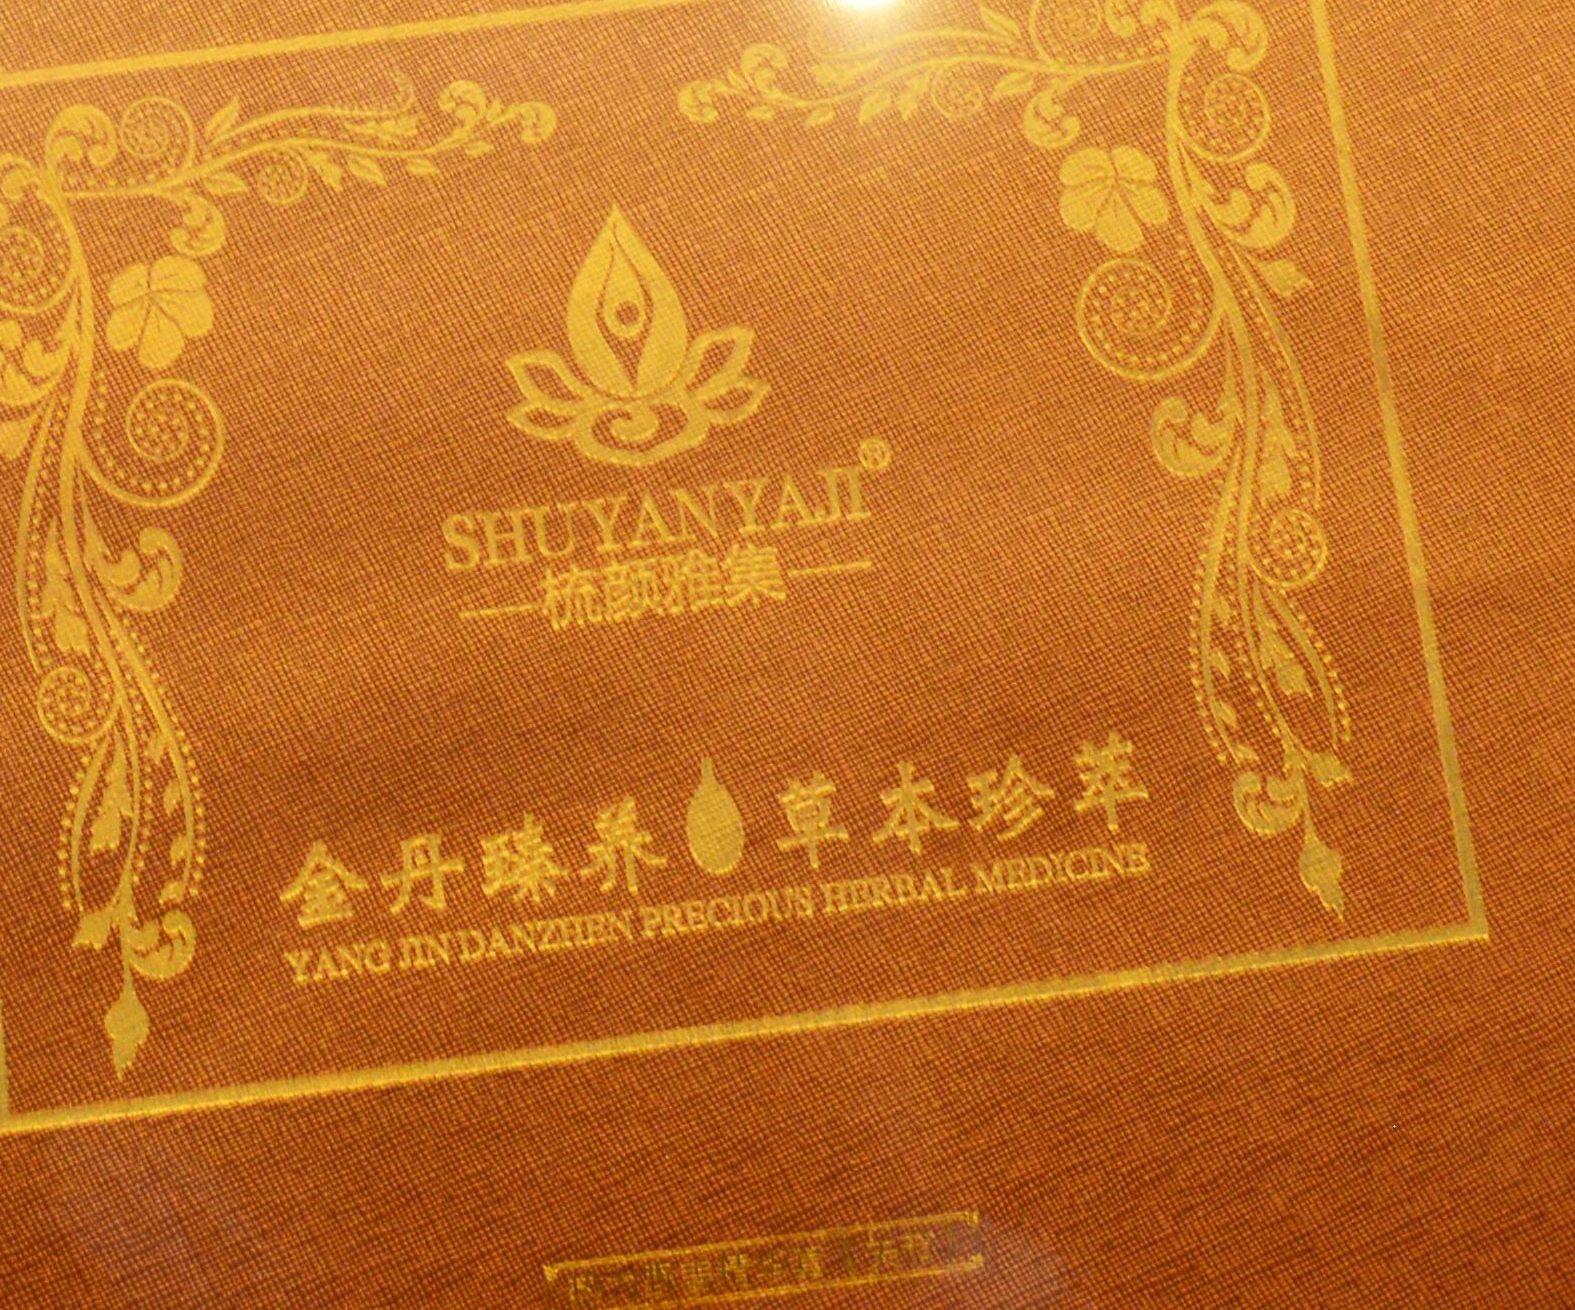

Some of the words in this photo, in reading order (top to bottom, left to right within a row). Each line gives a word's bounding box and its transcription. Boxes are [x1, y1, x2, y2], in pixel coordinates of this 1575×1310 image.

[440, 465, 872, 571] SHUYANYAJI
[775, 730, 1150, 869] 草本珍萃
[285, 941, 391, 984] YANG
[398, 933, 452, 968] JIN
[459, 911, 633, 964] DANZHEN
[642, 883, 815, 940] PRECIOUS
[825, 867, 969, 915] HERBAL
[974, 841, 1151, 897] MEDICINE
